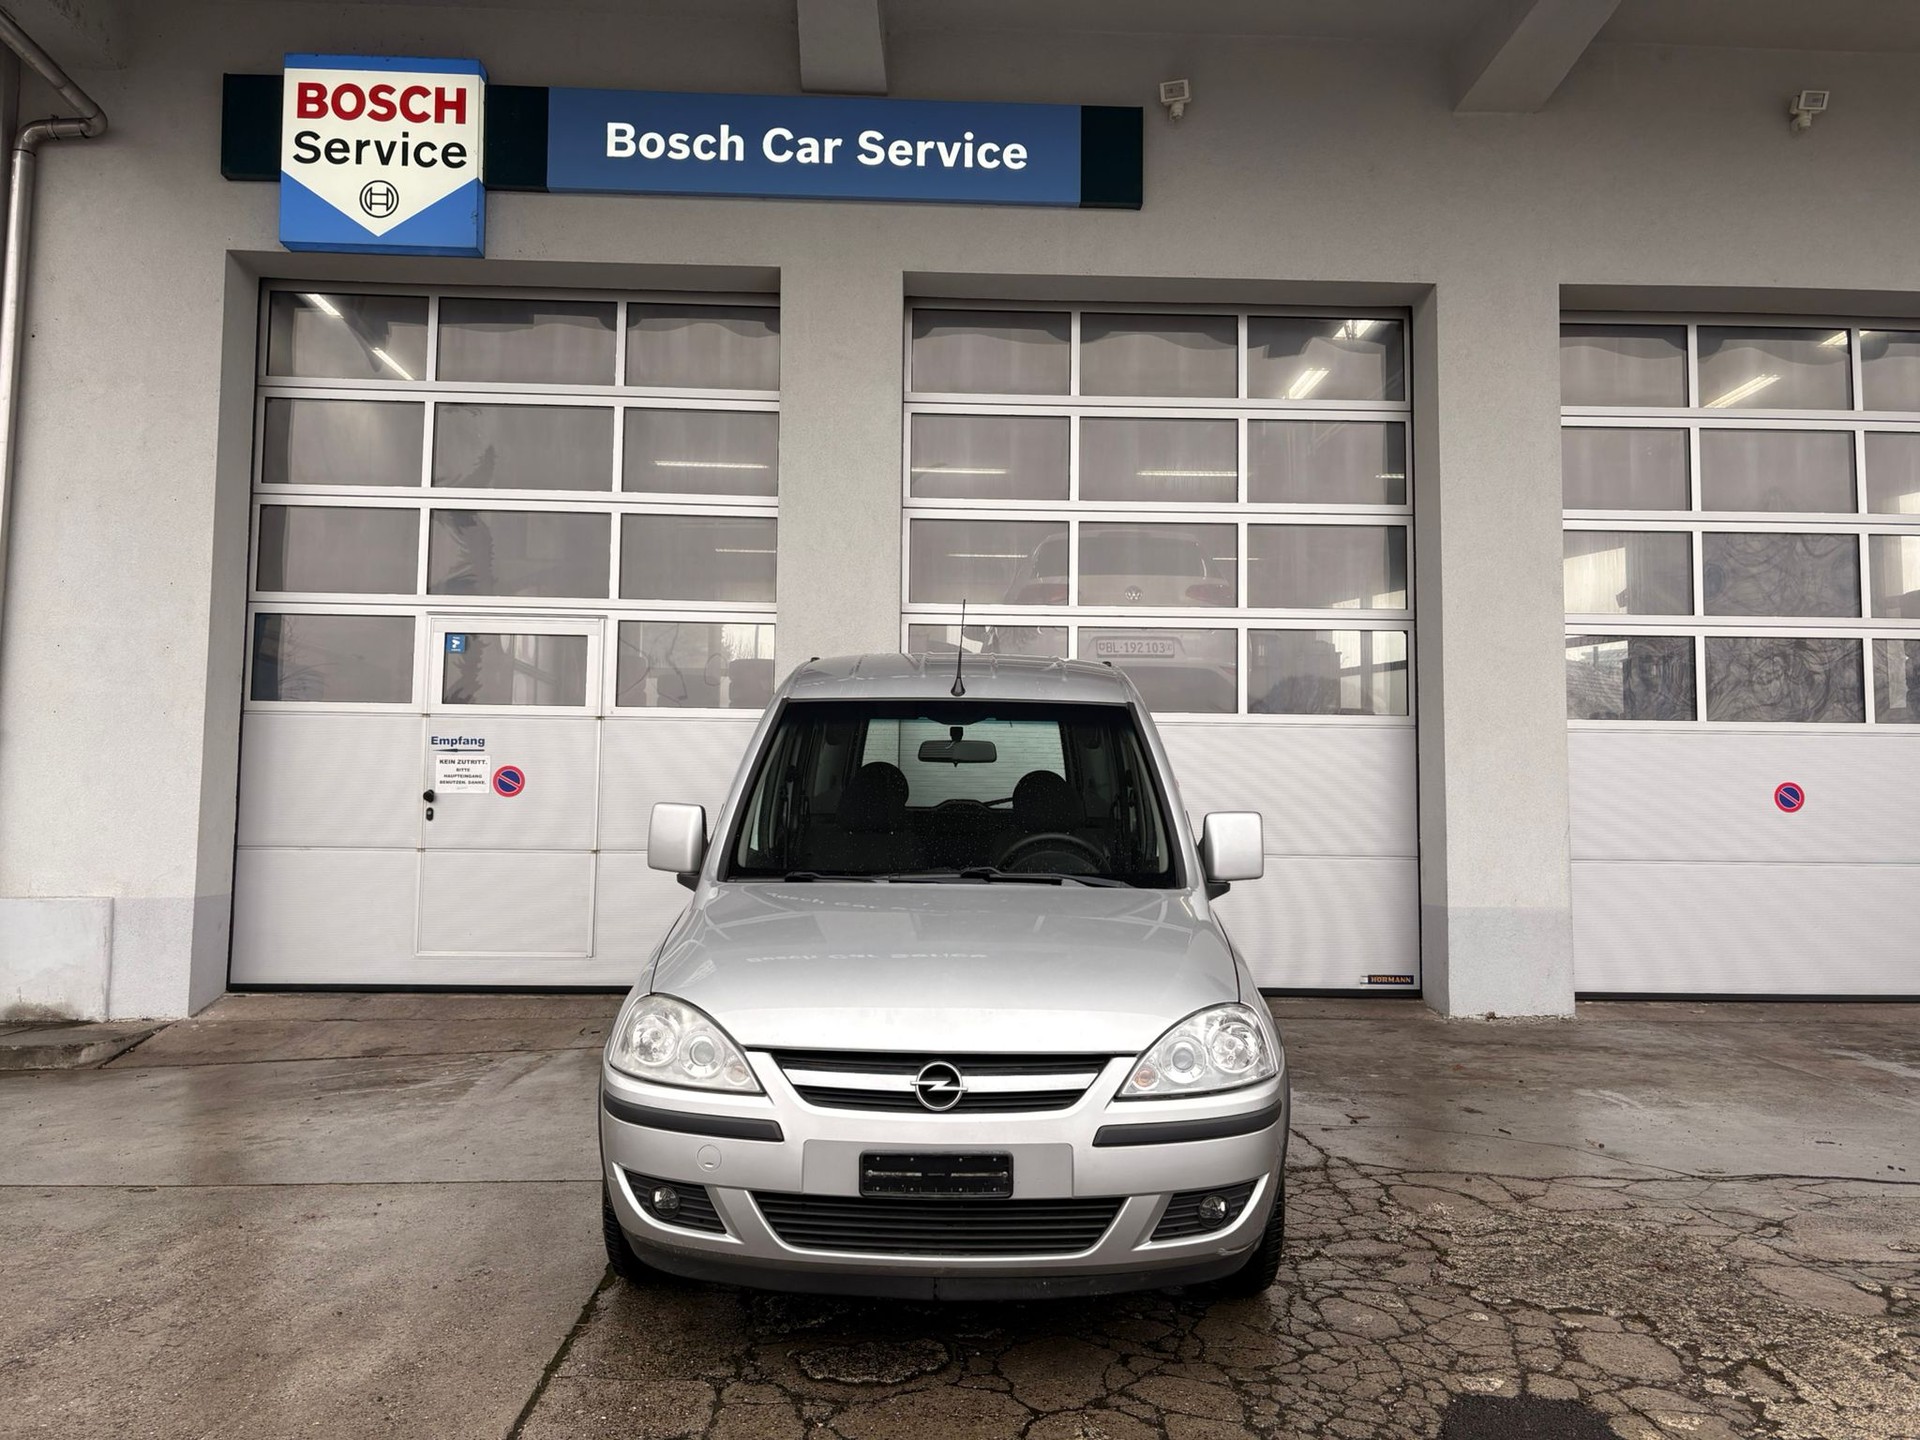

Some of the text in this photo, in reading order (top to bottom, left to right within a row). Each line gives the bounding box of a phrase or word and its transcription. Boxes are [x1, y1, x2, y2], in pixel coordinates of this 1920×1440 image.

[297, 82, 467, 124] BOSCH
[292, 130, 467, 169] Service
[606, 122, 1028, 170] Bosch Car Service
[431, 736, 485, 747] Empfang
